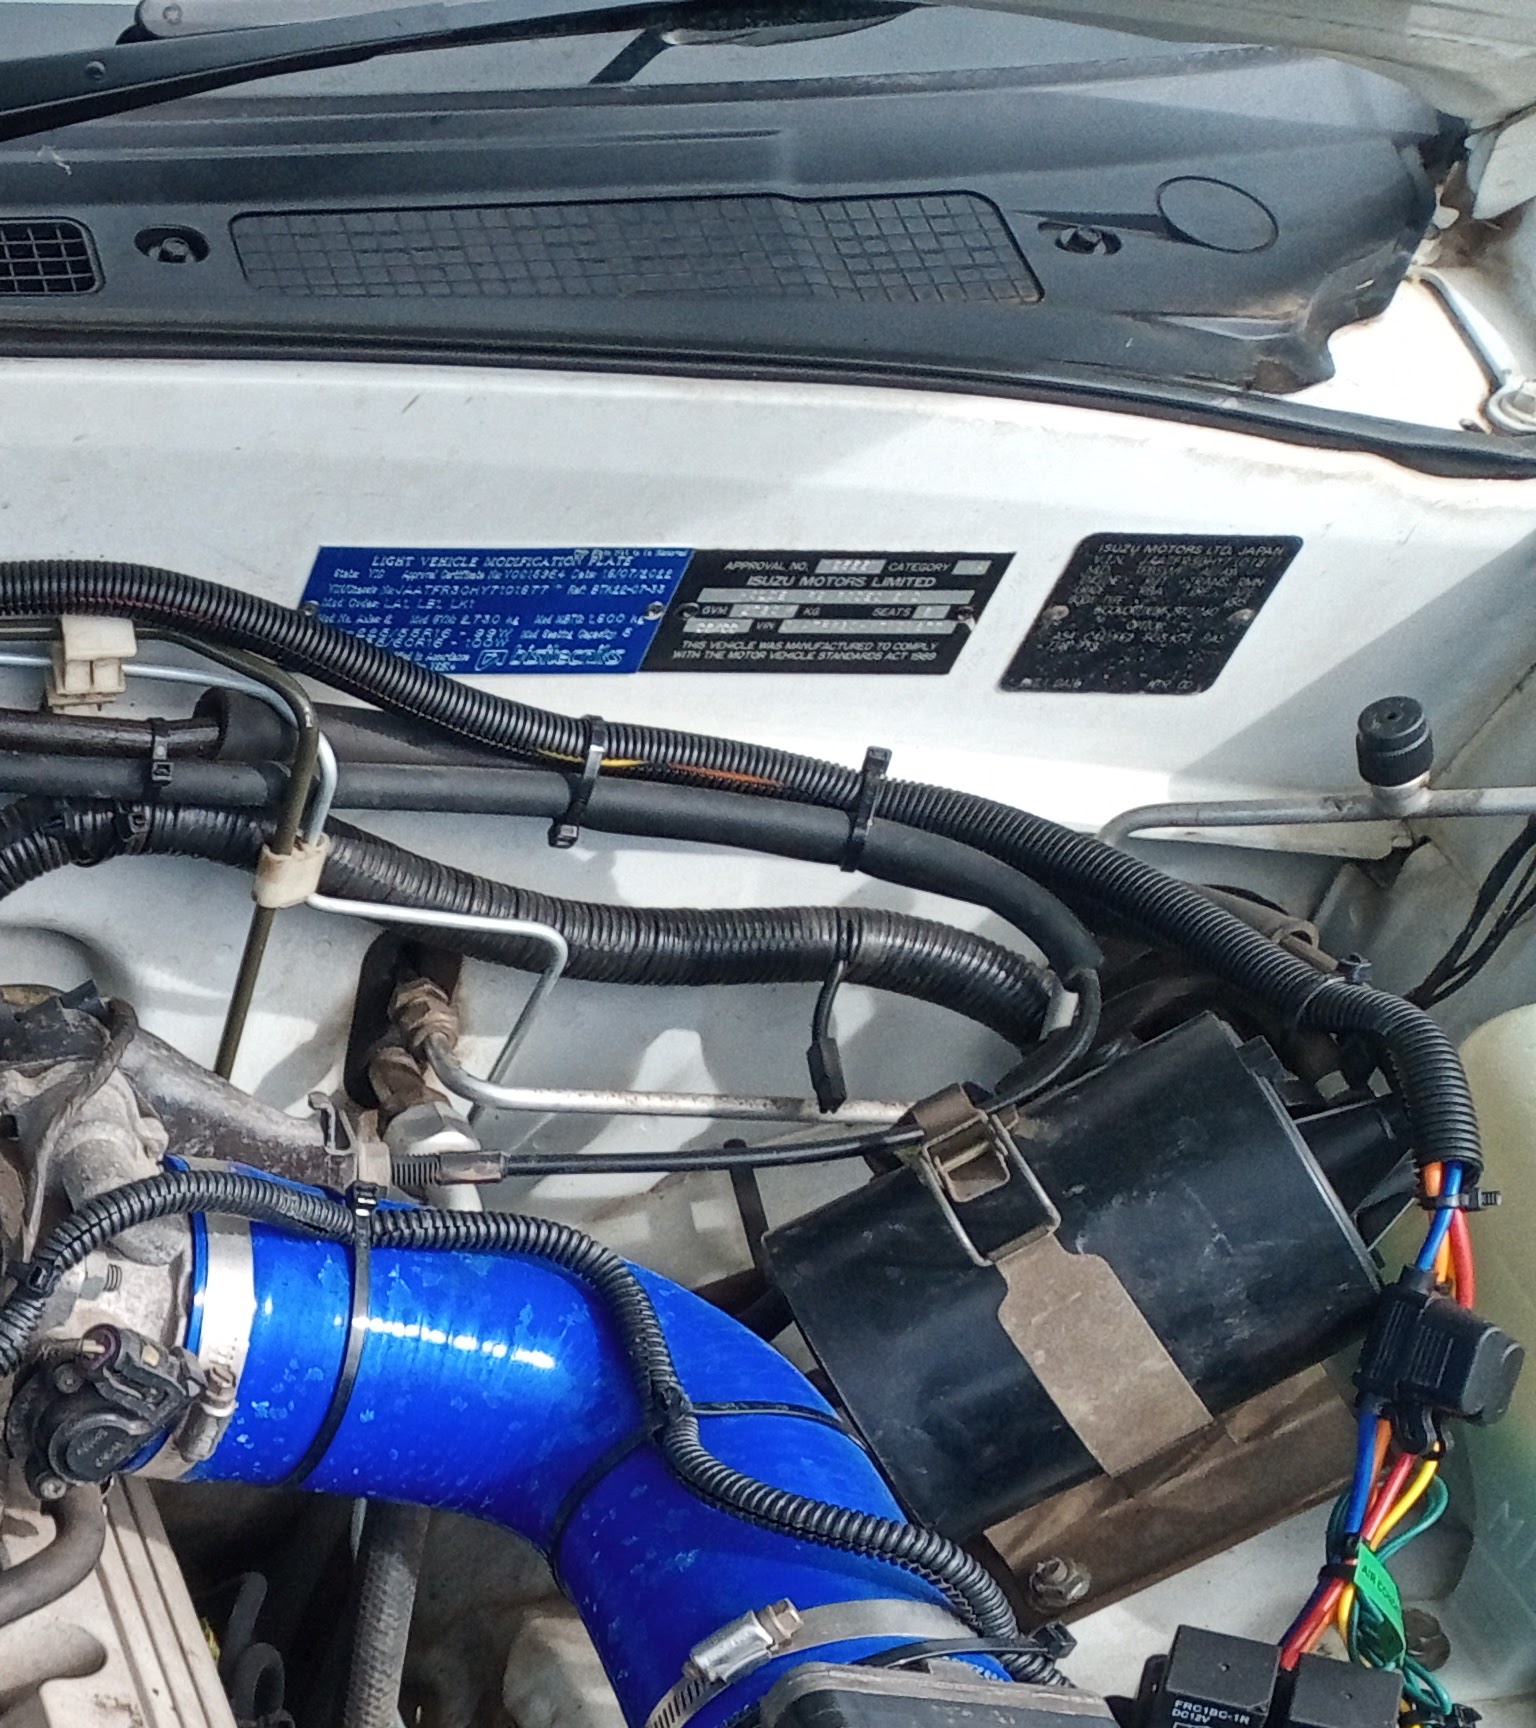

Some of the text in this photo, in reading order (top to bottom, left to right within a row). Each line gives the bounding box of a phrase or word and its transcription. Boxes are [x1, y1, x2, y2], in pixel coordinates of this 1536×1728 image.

[371, 556, 635, 568] LIGHT VEHICLE MODIFICATION PLATE
[724, 561, 788, 571] APPROVAL
[888, 562, 951, 572] CATEGORY
[747, 576, 937, 588] ISUZU MOTORS LIMITED
[701, 606, 729, 615] GVM
[872, 606, 912, 617] SEATS
[1171, 1708, 1211, 1723] DC12V
[1174, 1700, 1250, 1726] FRC1BC-1R
